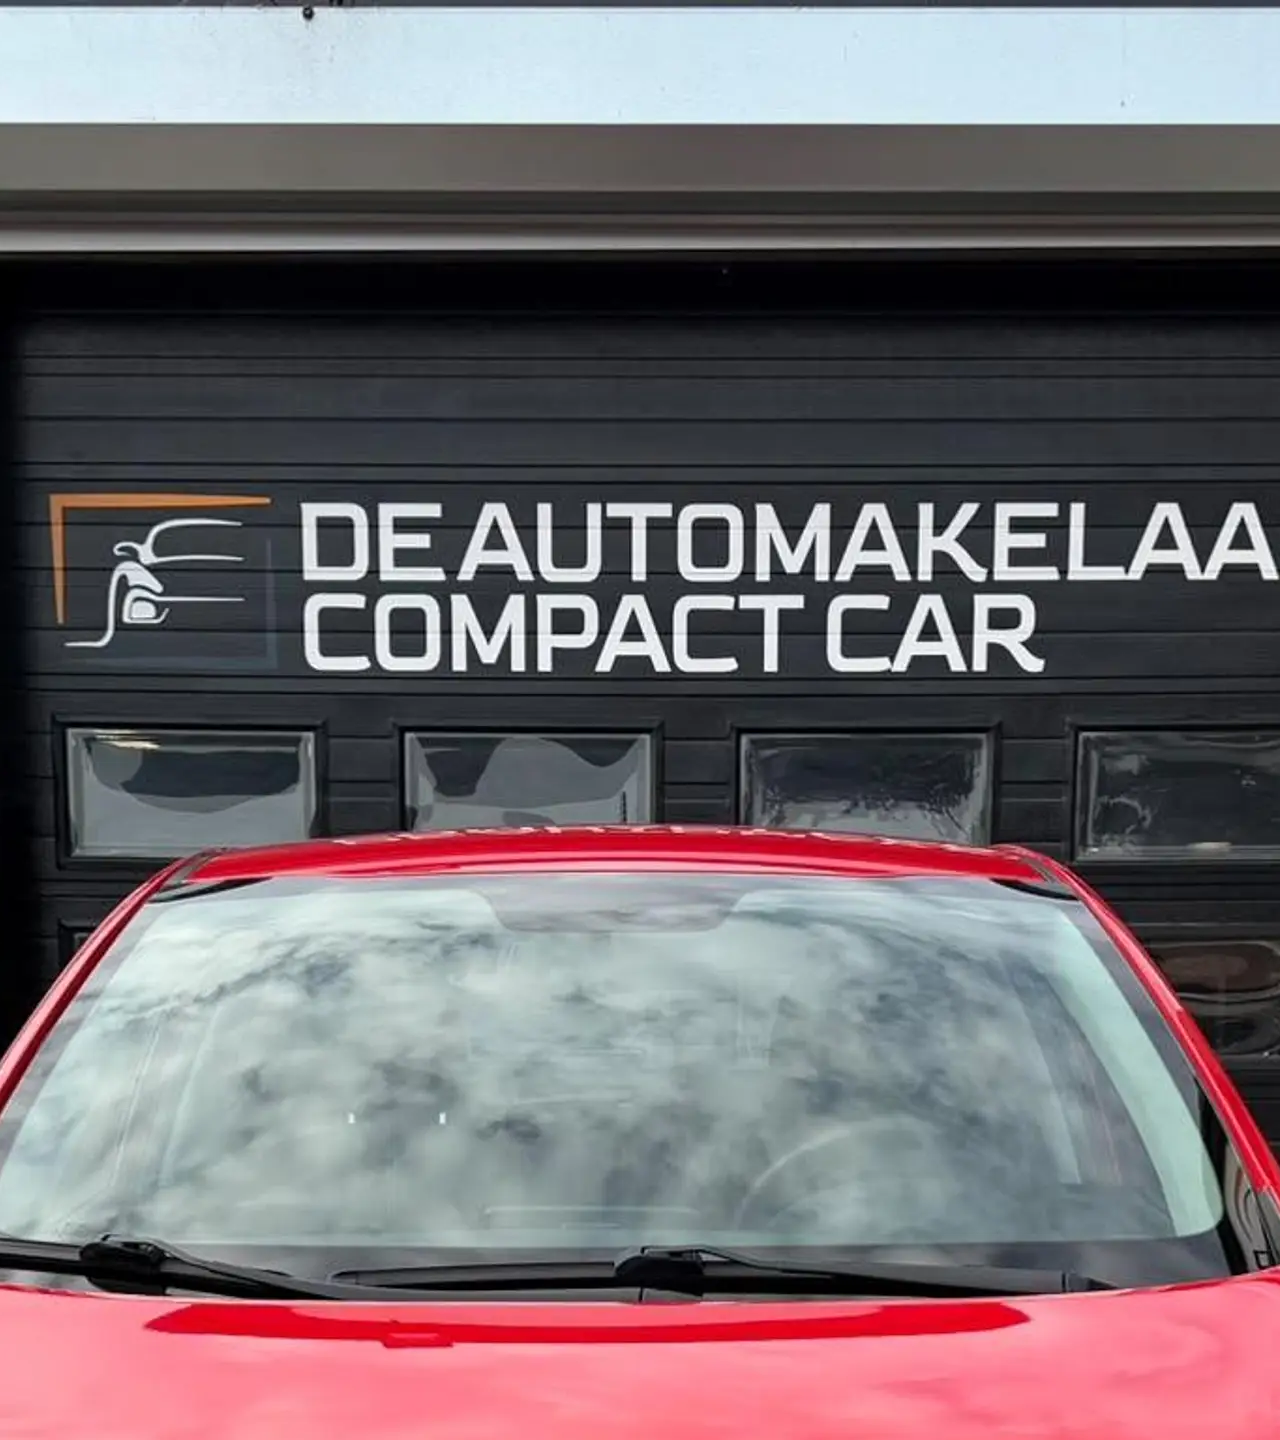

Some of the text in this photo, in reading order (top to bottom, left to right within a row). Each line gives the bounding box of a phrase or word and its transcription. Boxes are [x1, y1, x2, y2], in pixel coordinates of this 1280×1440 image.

[301, 503, 446, 581] DE
[304, 593, 1044, 672] COMPACT CAR
